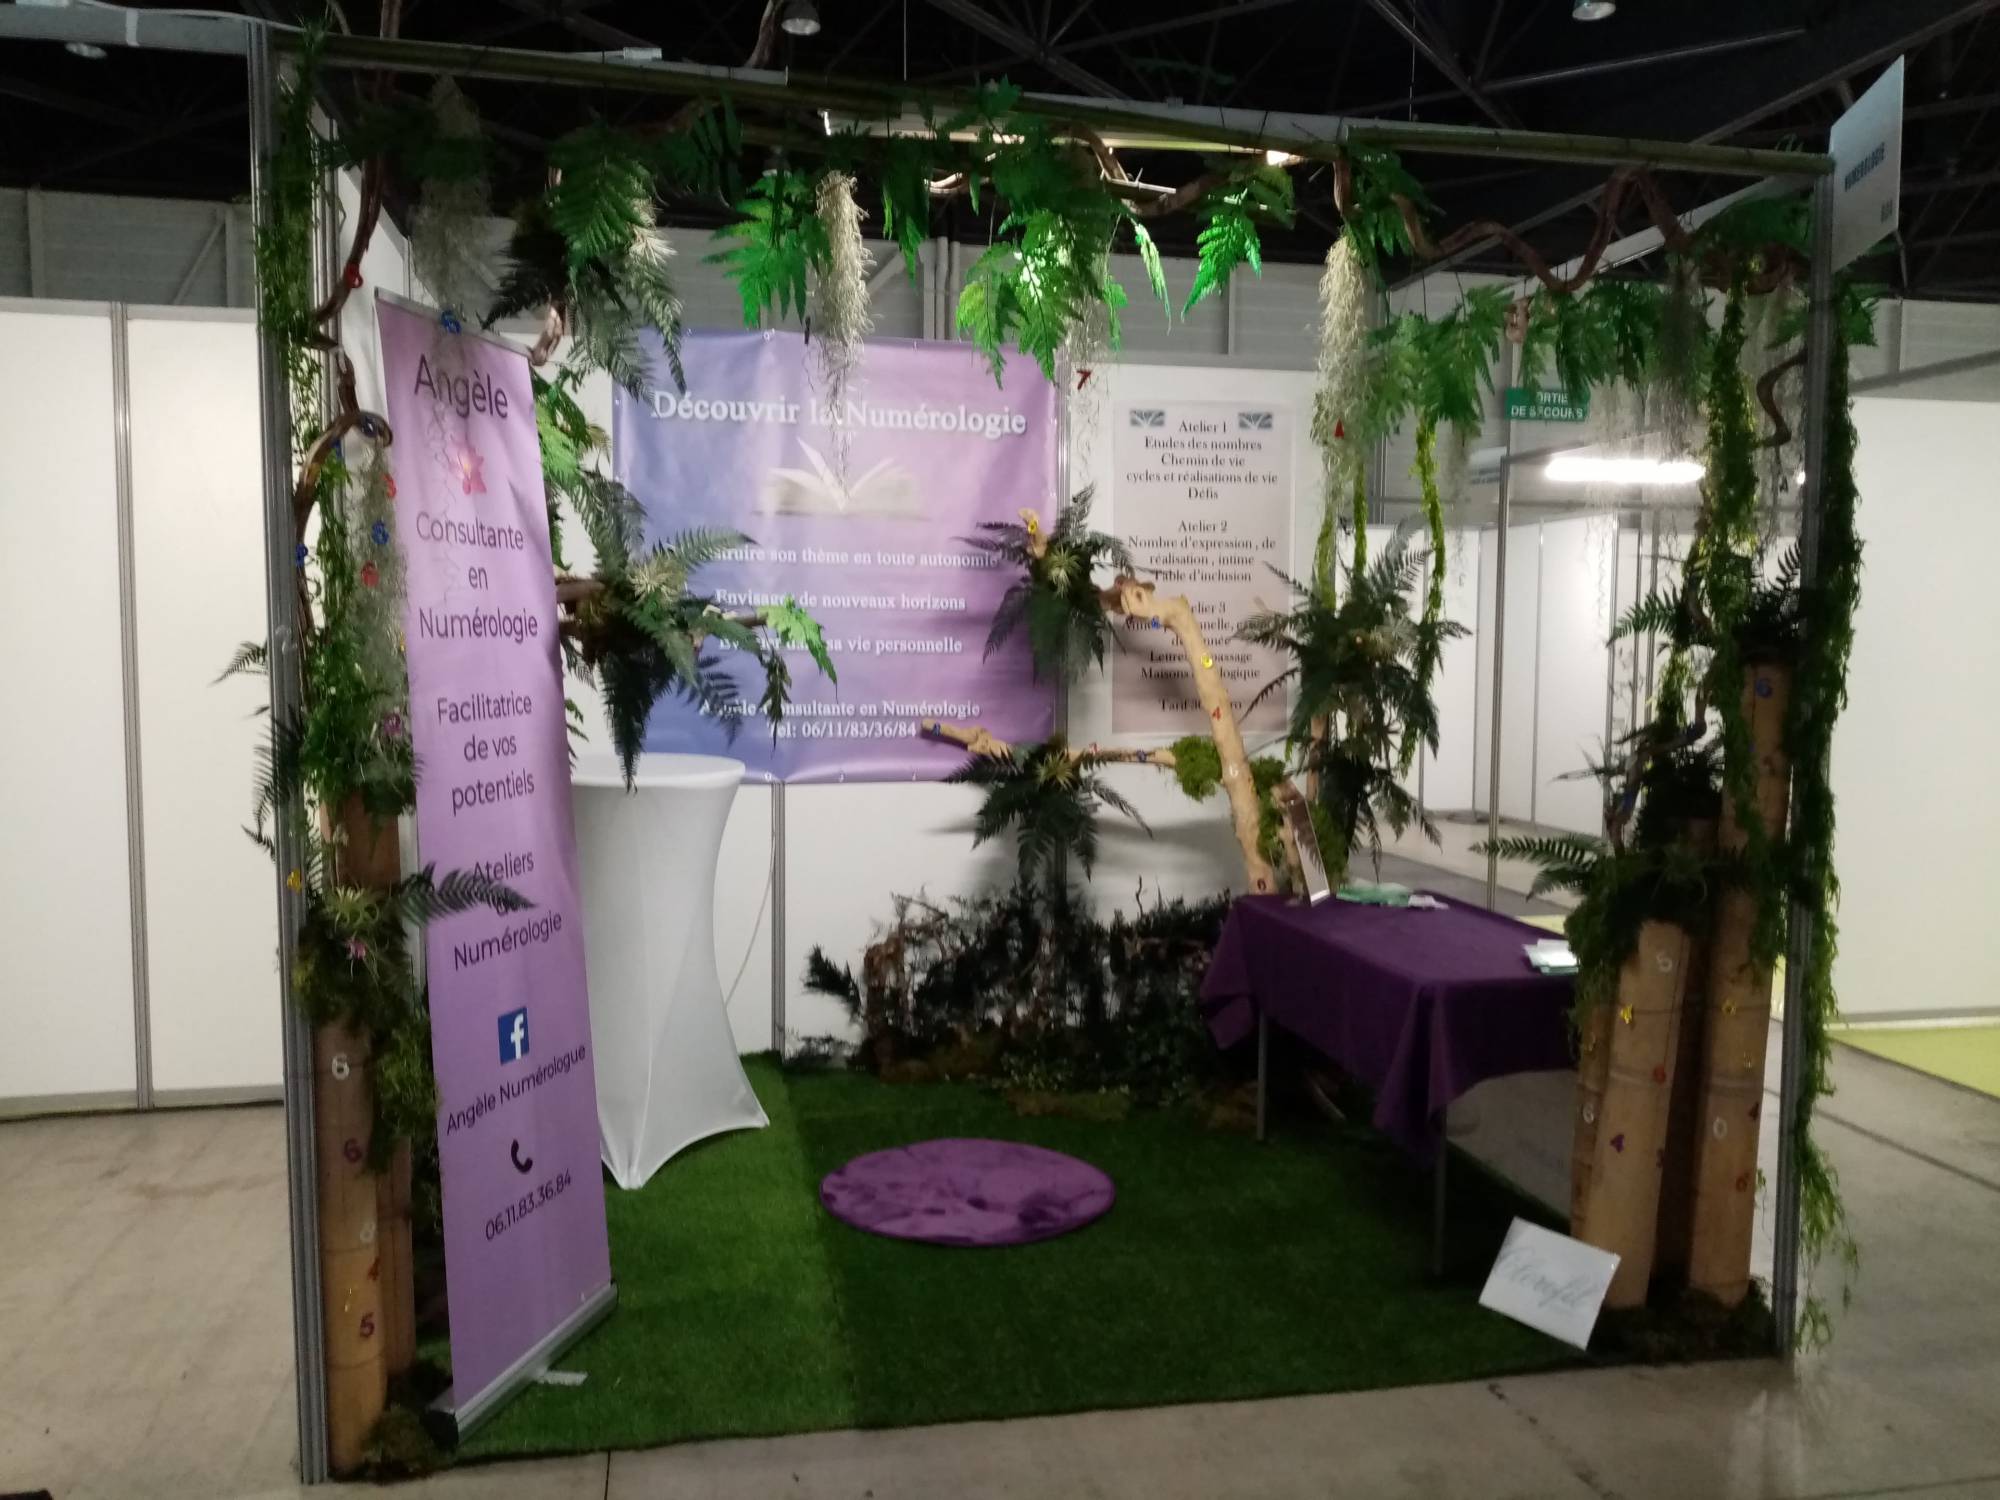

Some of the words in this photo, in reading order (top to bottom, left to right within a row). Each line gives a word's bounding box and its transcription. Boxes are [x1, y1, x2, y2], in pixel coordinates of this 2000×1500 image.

[414, 353, 508, 418] Angèle
[1534, 391, 1568, 405] ORTIE
[651, 391, 800, 425] Découvrir
[847, 401, 1027, 440] Numérologie
[1511, 405, 1527, 417] DE
[1179, 420, 1218, 433] Atelier
[1187, 436, 1208, 449] des
[1211, 438, 1262, 451] nombres
[1161, 453, 1209, 466] Chemin
[1211, 453, 1226, 467] de
[1229, 457, 1245, 467] vie
[1126, 470, 1161, 484] cycles
[1163, 472, 1175, 482] et
[1178, 470, 1242, 483] réalisations
[1244, 471, 1259, 483] de
[1262, 473, 1278, 484] vie
[1188, 487, 1219, 500] Défis
[416, 511, 524, 550] Consultante
[1178, 519, 1216, 532] Atelier
[1220, 520, 1228, 533] 2
[1128, 536, 1178, 549] Nombre
[1180, 536, 1252, 551] d'expression
[1261, 537, 1276, 549] de
[769, 549, 797, 562] son
[853, 552, 871, 565] en
[877, 551, 915, 566] toute
[920, 552, 999, 568] autonomie
[1218, 554, 1255, 567] intime
[467, 565, 489, 590] en
[1189, 570, 1251, 582] d'inclusion
[799, 591, 818, 607] de
[822, 594, 896, 609] nouveaux
[900, 594, 966, 611] horizons
[419, 607, 538, 644] Numérologie
[848, 636, 871, 652] vie
[876, 637, 962, 655] personnelle
[437, 690, 532, 725] Facilitatrice
[860, 704, 877, 716] en
[882, 700, 980, 718] Numérologie
[802, 721, 917, 739] 06/11/83/36/84
[463, 734, 488, 762] de
[492, 735, 517, 757] vos
[452, 768, 535, 816] potentiels
[472, 852, 535, 887] Ateliers
[453, 911, 563, 972] Numérologie
[446, 1093, 496, 1136] Angèle
[499, 1045, 586, 1105] Numérologue
[485, 1168, 572, 1241] 06.11.83.36.84
